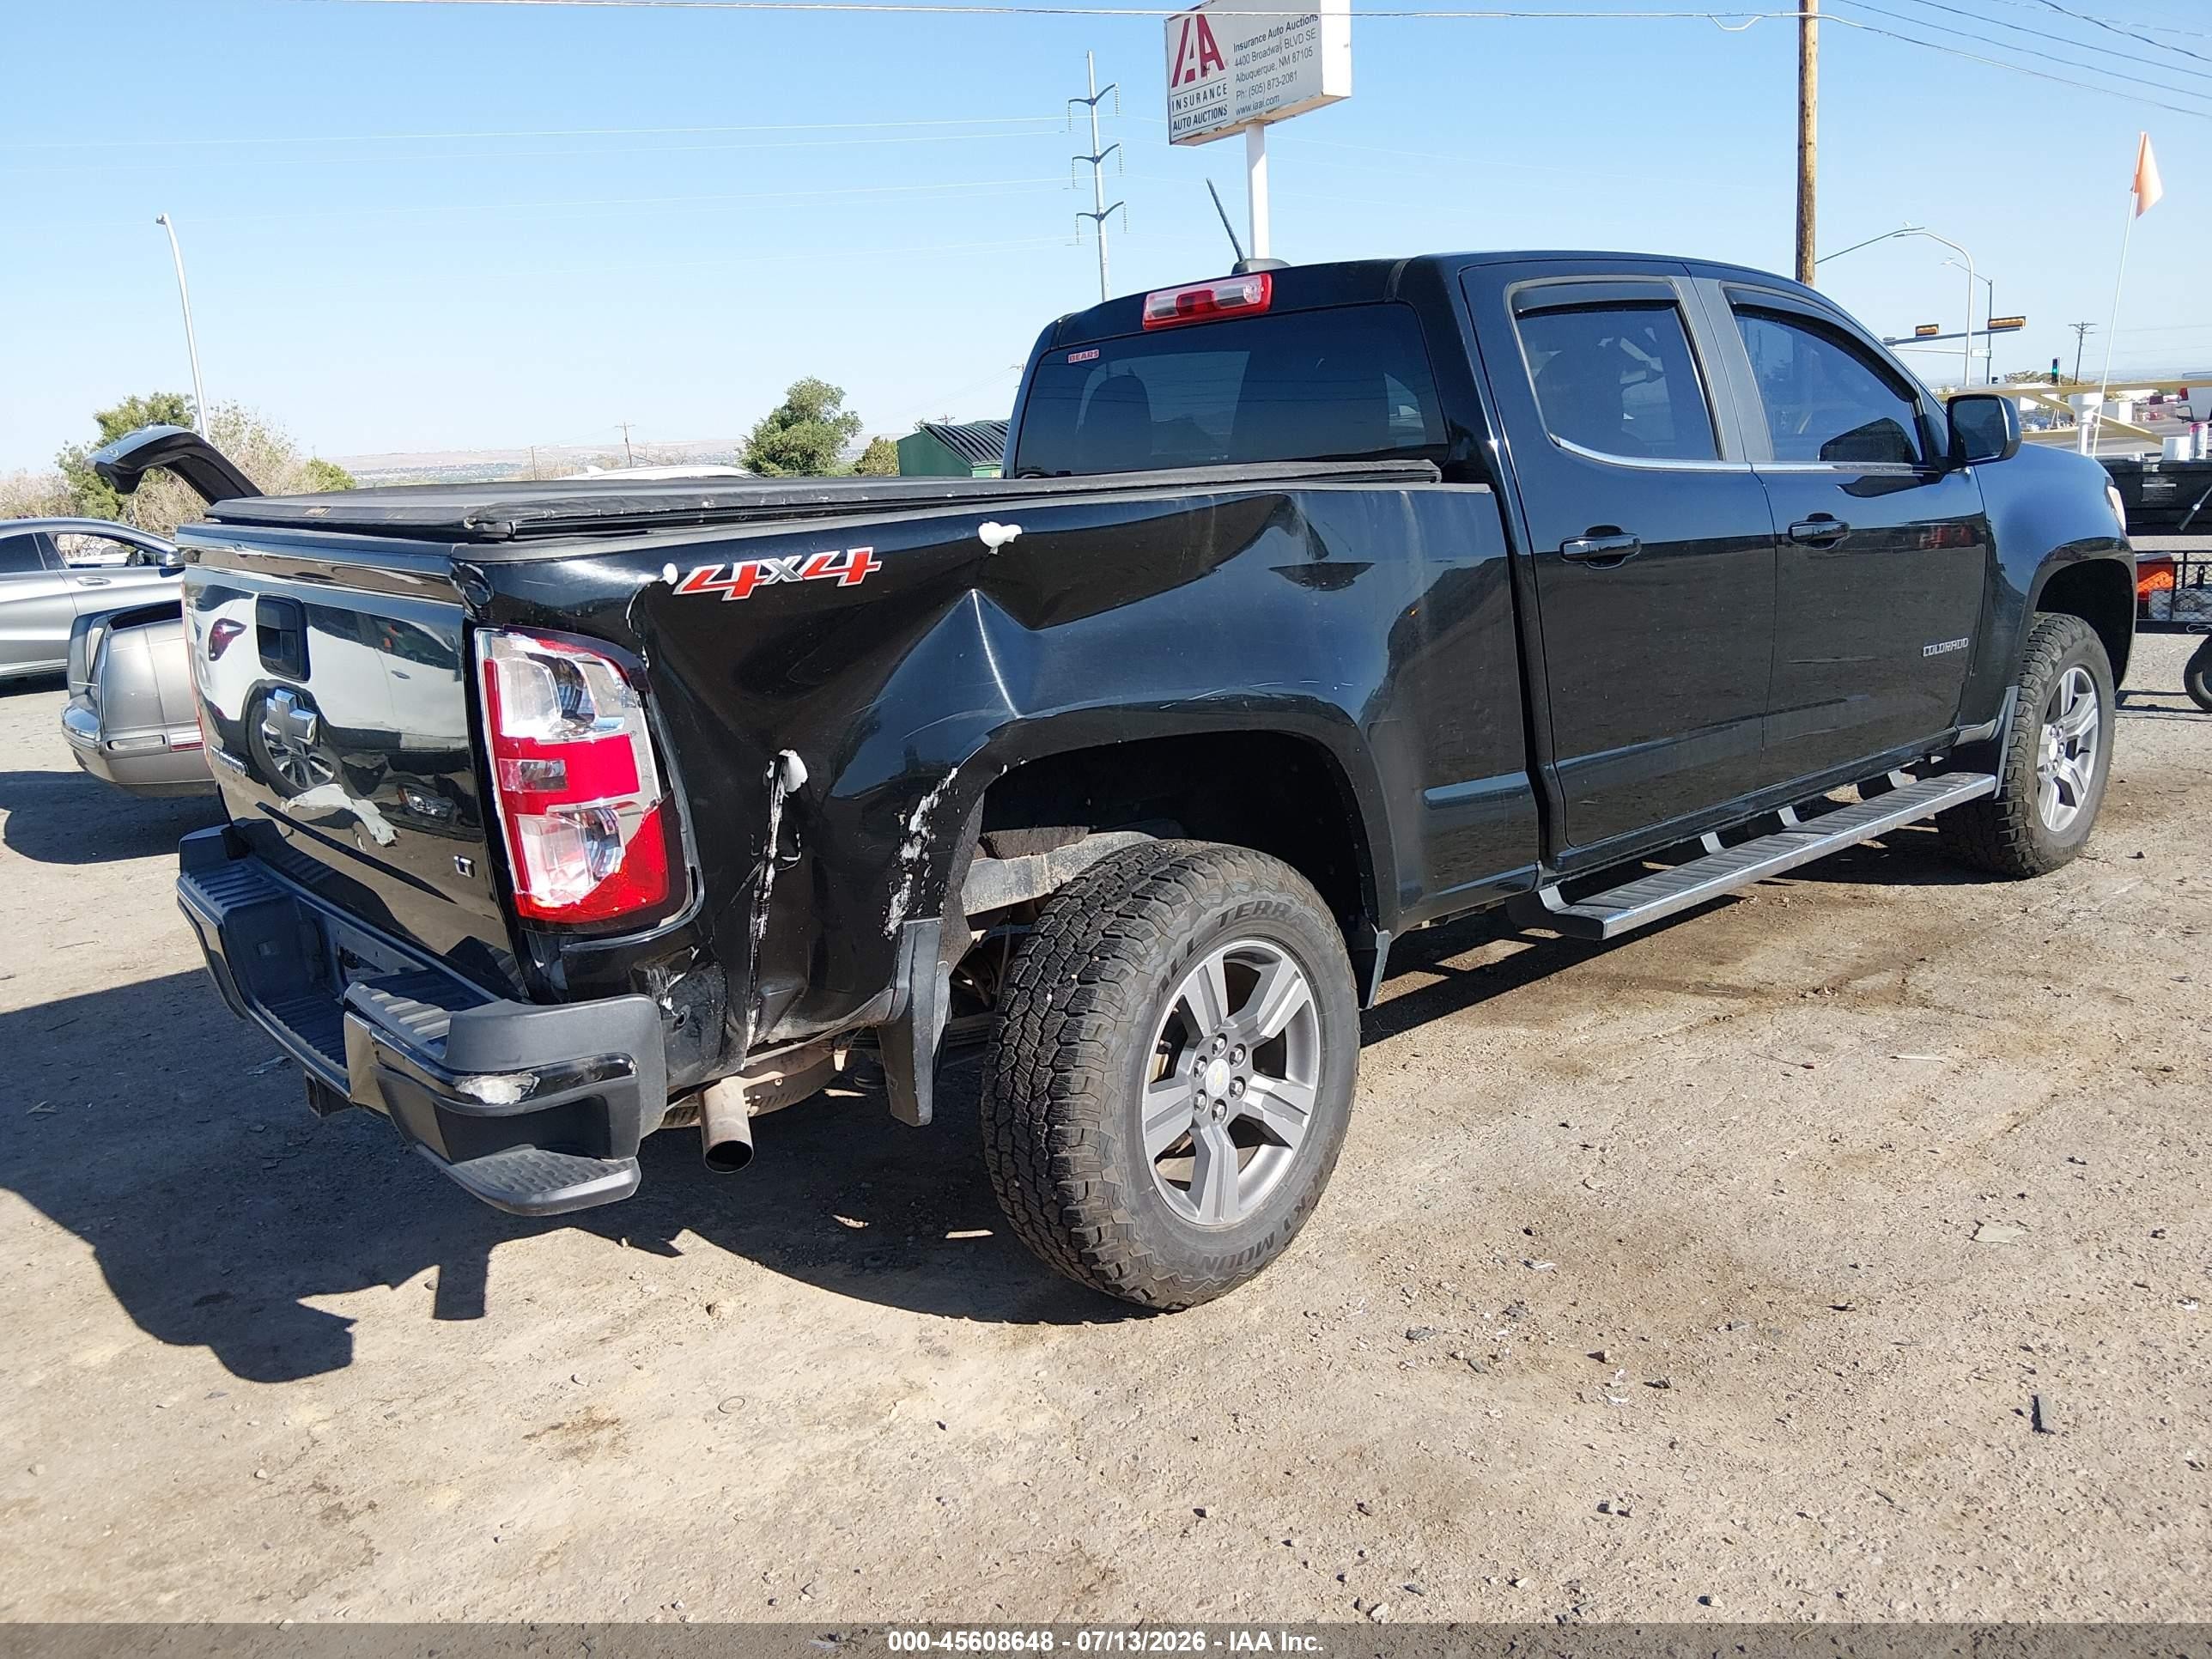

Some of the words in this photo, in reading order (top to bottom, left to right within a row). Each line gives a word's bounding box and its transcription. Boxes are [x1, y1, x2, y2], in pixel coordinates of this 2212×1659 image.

[1234, 33, 1267, 53] Insurance
[1268, 27, 1284, 40] Auto
[1285, 15, 1318, 33] Auctions
[1235, 53, 1250, 68] 4400
[1252, 42, 1283, 62] Broadway
[1285, 33, 1304, 49] BLVD
[1305, 27, 1316, 41] SE
[1279, 55, 1290, 68] NM
[1292, 46, 1313, 64] 87105
[1172, 83, 1227, 112] INSURANCE
[1249, 82, 1266, 99] (505)
[1267, 70, 1297, 90] 873-2081
[1173, 116, 1192, 132] AUTO
[1193, 104, 1228, 126] AUCTIONS
[1236, 95, 1280, 115] www.iaai.com
[1069, 350, 1099, 362] BEARS
[1923, 637, 1969, 658] COLORADO
